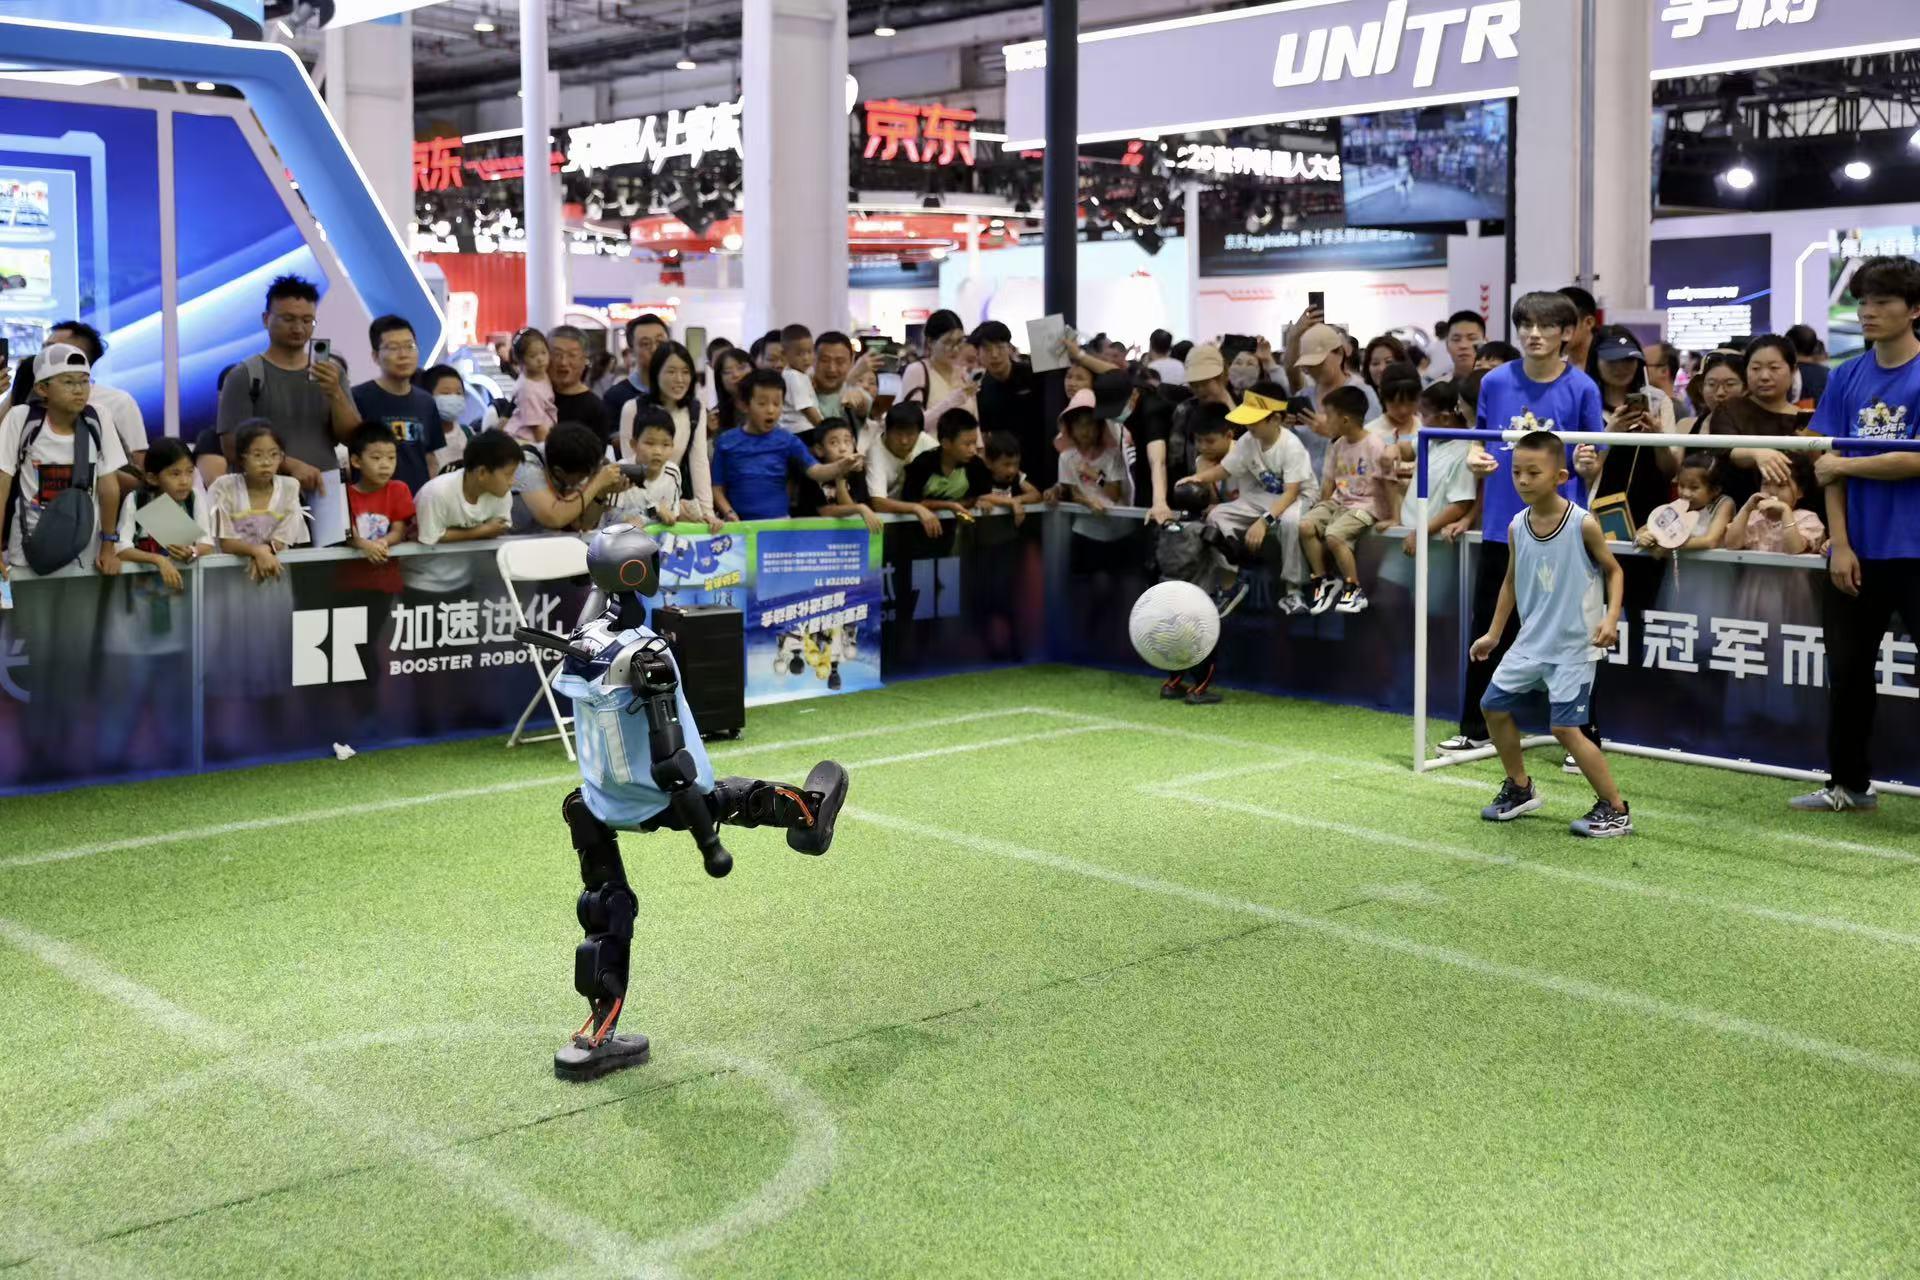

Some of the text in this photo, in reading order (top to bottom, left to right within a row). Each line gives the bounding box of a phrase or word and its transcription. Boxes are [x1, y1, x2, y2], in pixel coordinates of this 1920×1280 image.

[864, 98, 976, 166] 京东
[389, 593, 565, 652] 加速进化
[389, 654, 472, 676] BOOSTER
